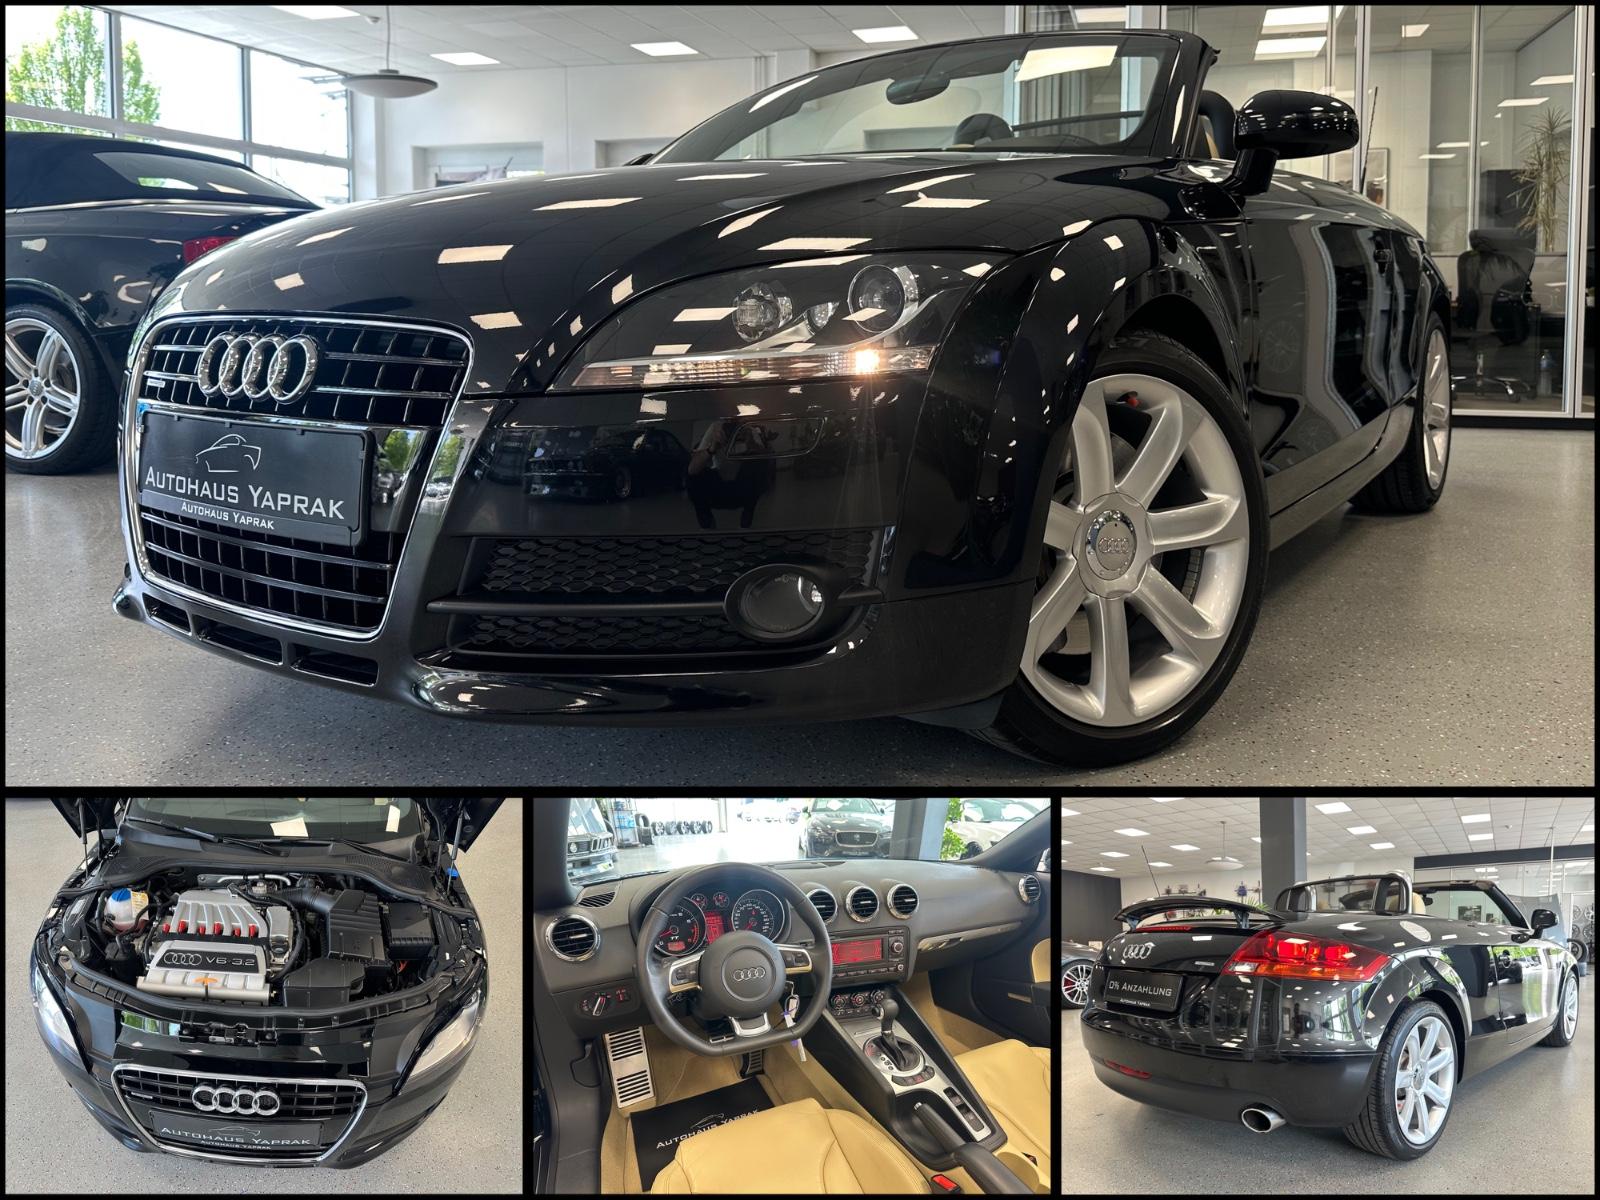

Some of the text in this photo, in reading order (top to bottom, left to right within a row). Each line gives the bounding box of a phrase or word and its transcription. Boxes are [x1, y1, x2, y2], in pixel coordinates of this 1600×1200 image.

[145, 466, 345, 520] AUTOHAUS YAPRAK
[181, 501, 275, 530] AUTOHAUS YAPRAK
[1121, 981, 1173, 997] ANZAHLUNG
[161, 1127, 311, 1146] AUTOHAUS YAPRAK
